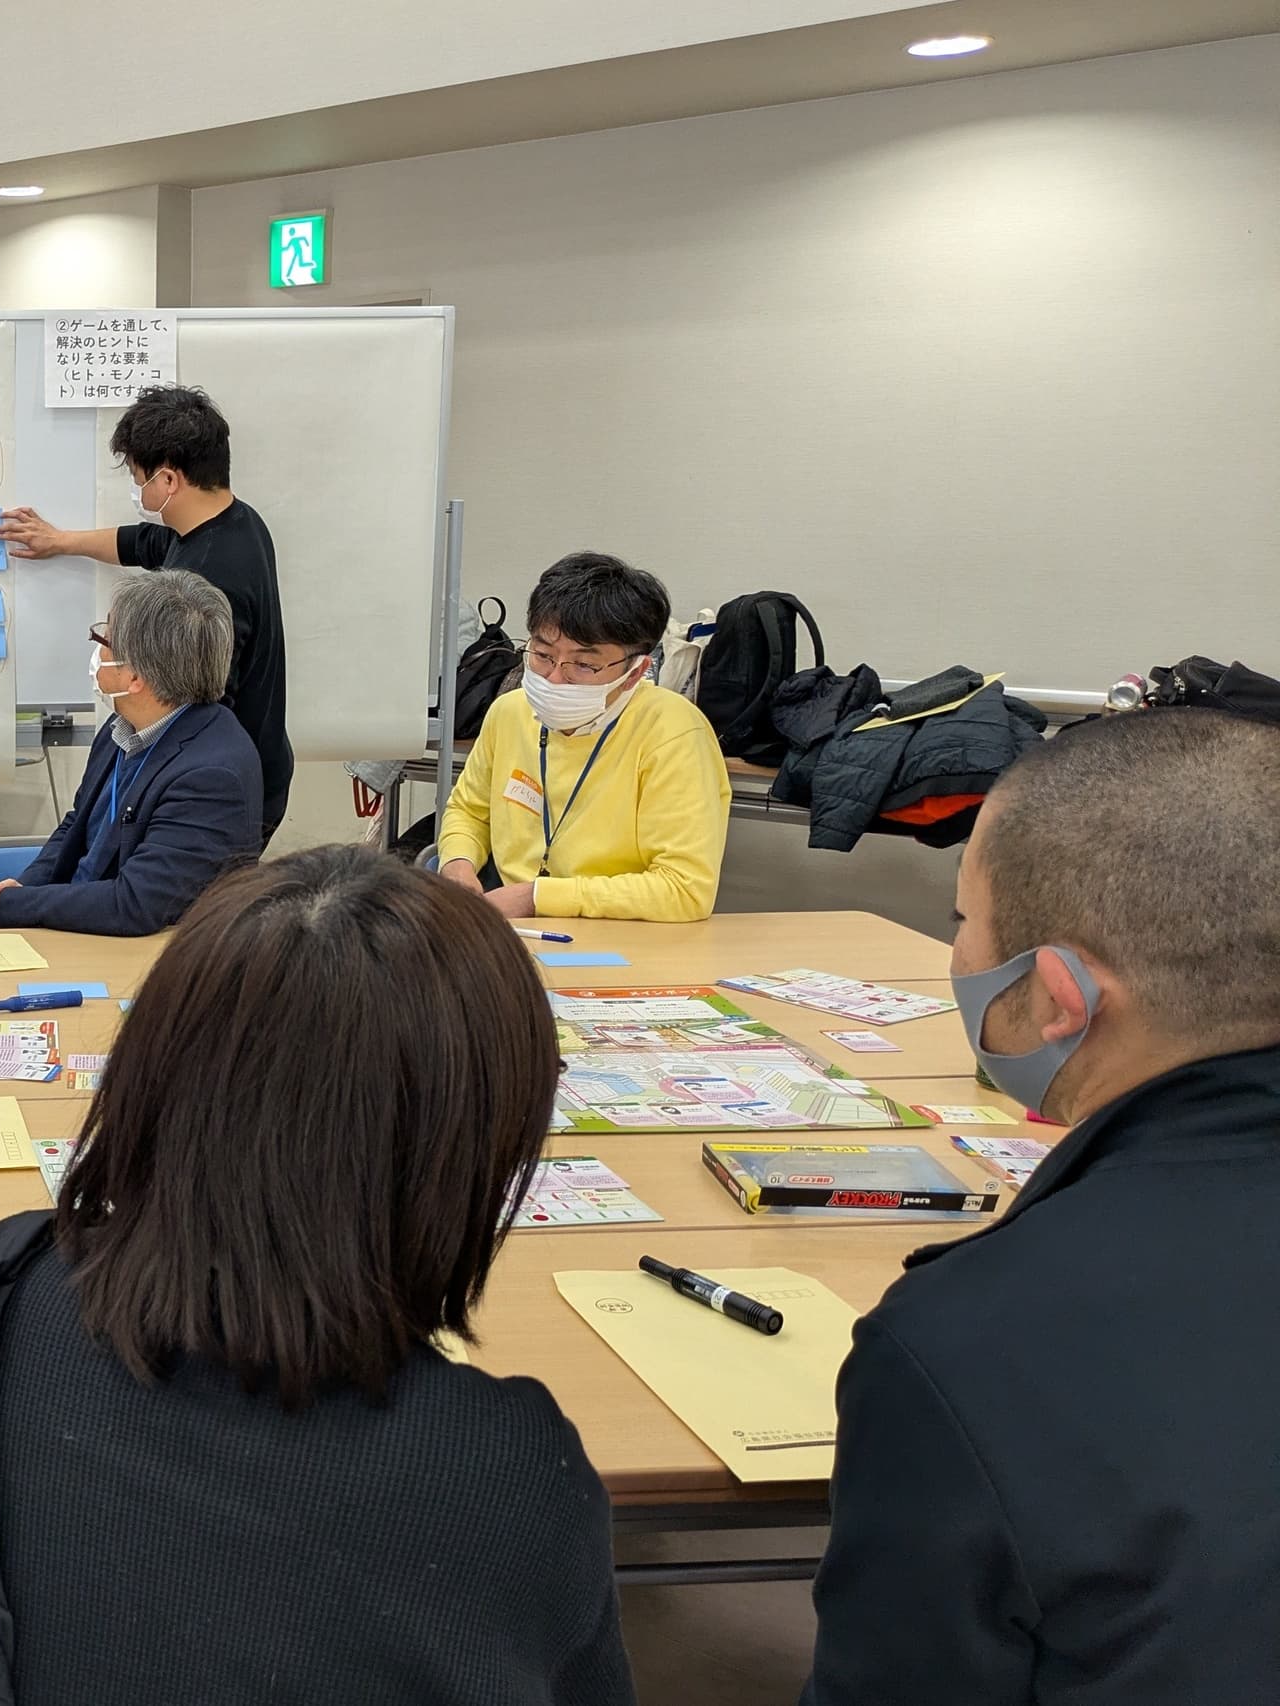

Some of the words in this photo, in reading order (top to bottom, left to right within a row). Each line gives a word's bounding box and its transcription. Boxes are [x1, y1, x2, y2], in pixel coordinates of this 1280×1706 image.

[56, 319, 168, 333] ②ゲームを通して、
[56, 336, 149, 349] 解決のヒントに
[57, 352, 149, 365] なりそうな要素
[64, 368, 161, 382] （ヒト・モノ・コ
[826, 1191, 904, 1208] PROCKEY
